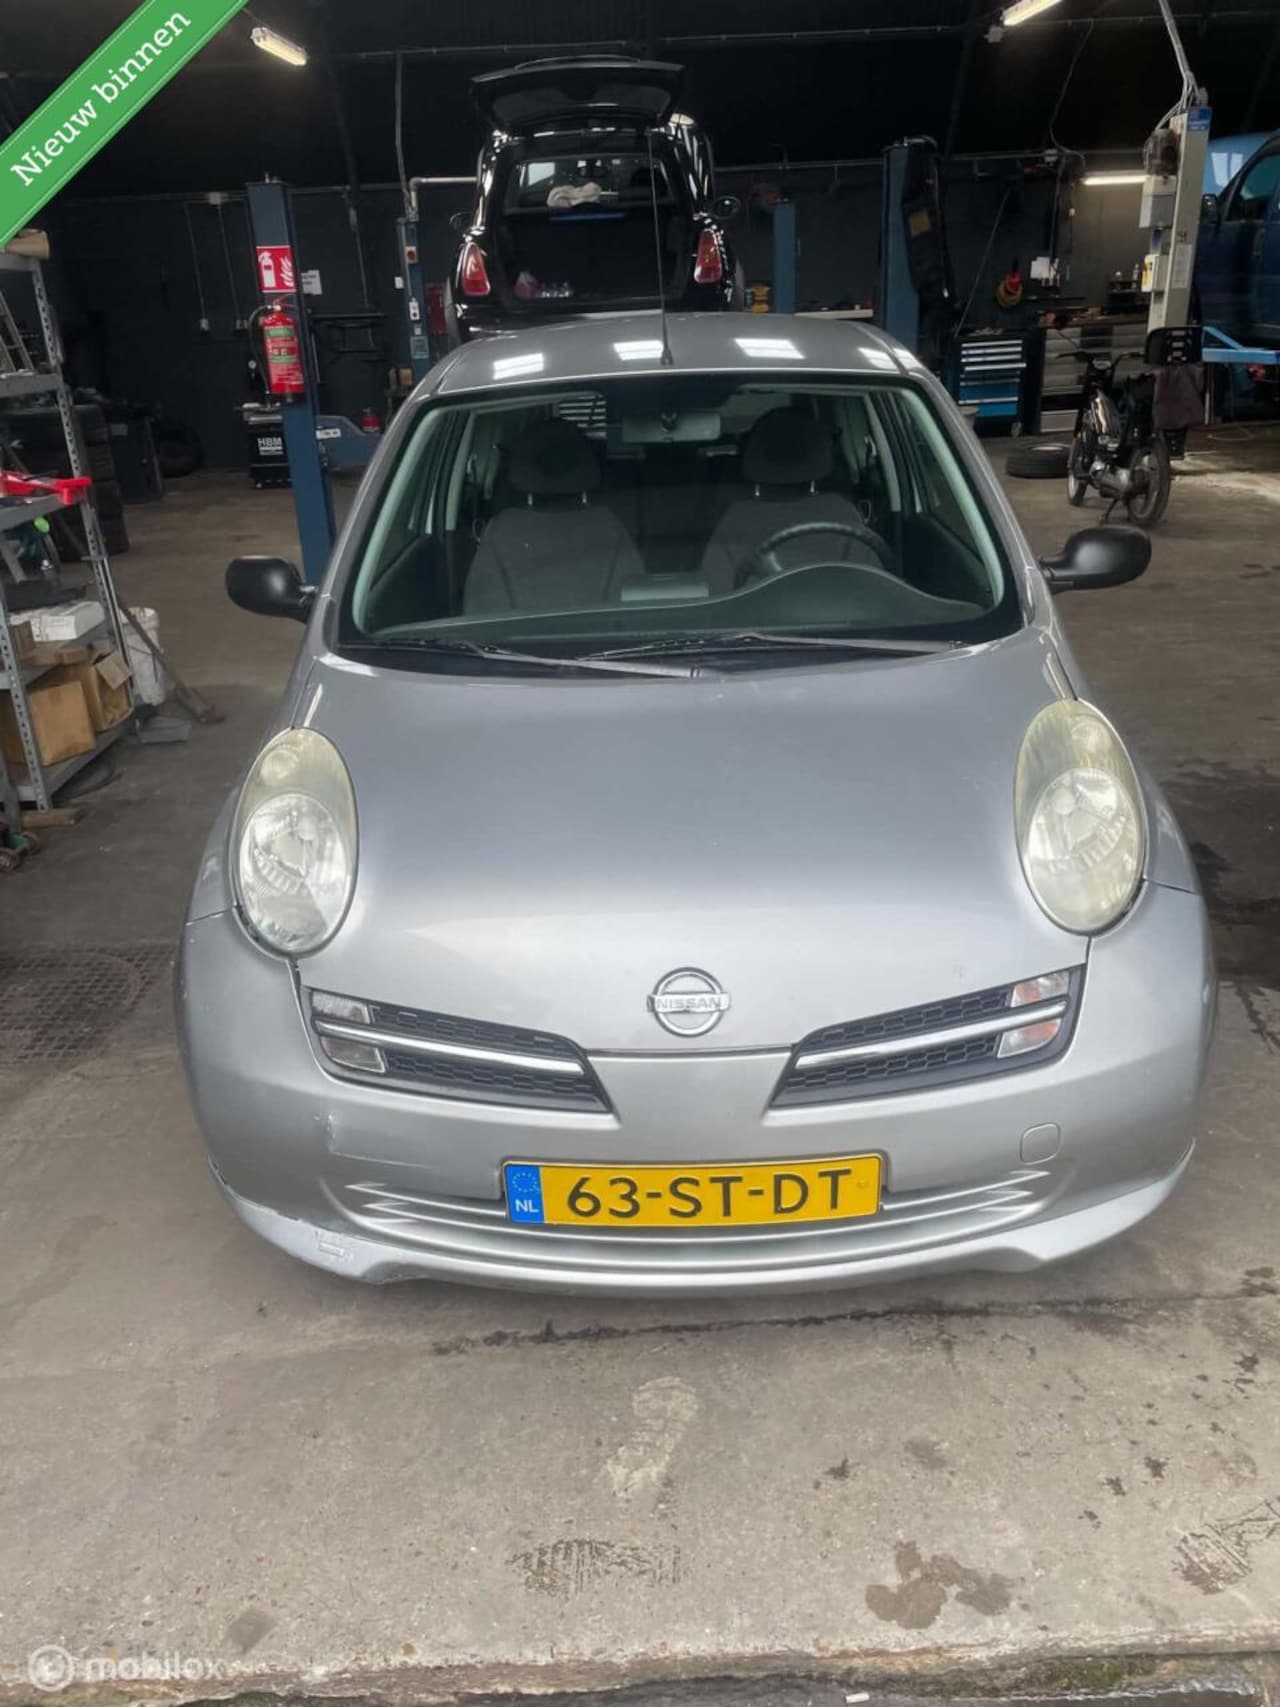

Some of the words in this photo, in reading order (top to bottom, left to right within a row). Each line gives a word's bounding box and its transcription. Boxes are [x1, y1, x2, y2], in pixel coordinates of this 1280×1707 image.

[257, 437, 283, 447] HBM
[656, 997, 721, 1009] NISSAN
[567, 1168, 852, 1218] 63-ST-DT
[515, 1199, 539, 1213] NL
